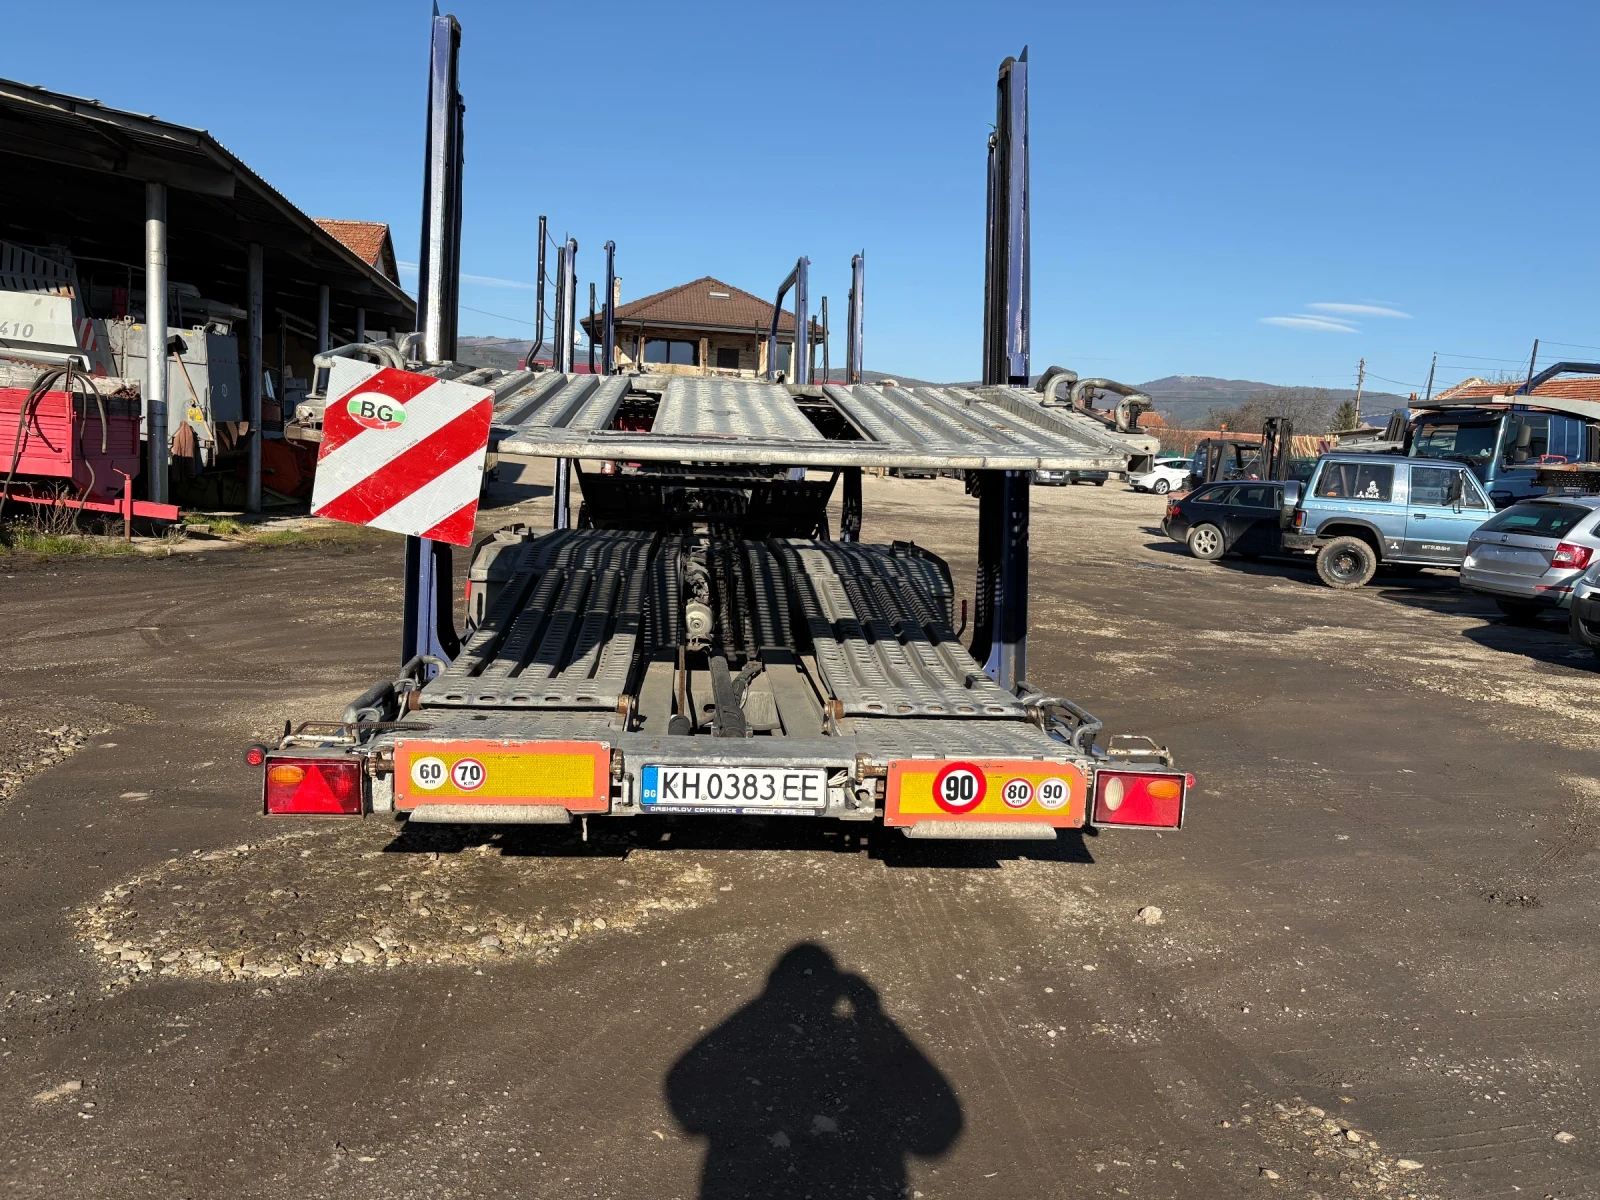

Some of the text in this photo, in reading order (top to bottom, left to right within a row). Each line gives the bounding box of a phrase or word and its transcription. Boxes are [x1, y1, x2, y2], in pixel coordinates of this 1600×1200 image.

[361, 401, 393, 422] BG
[419, 764, 441, 779] 60
[458, 765, 481, 781] 70
[643, 789, 657, 798] BG
[662, 772, 819, 801] KH 0383 EE
[945, 775, 974, 801] 90
[1007, 784, 1028, 799] 80
[1043, 784, 1063, 799] 90
